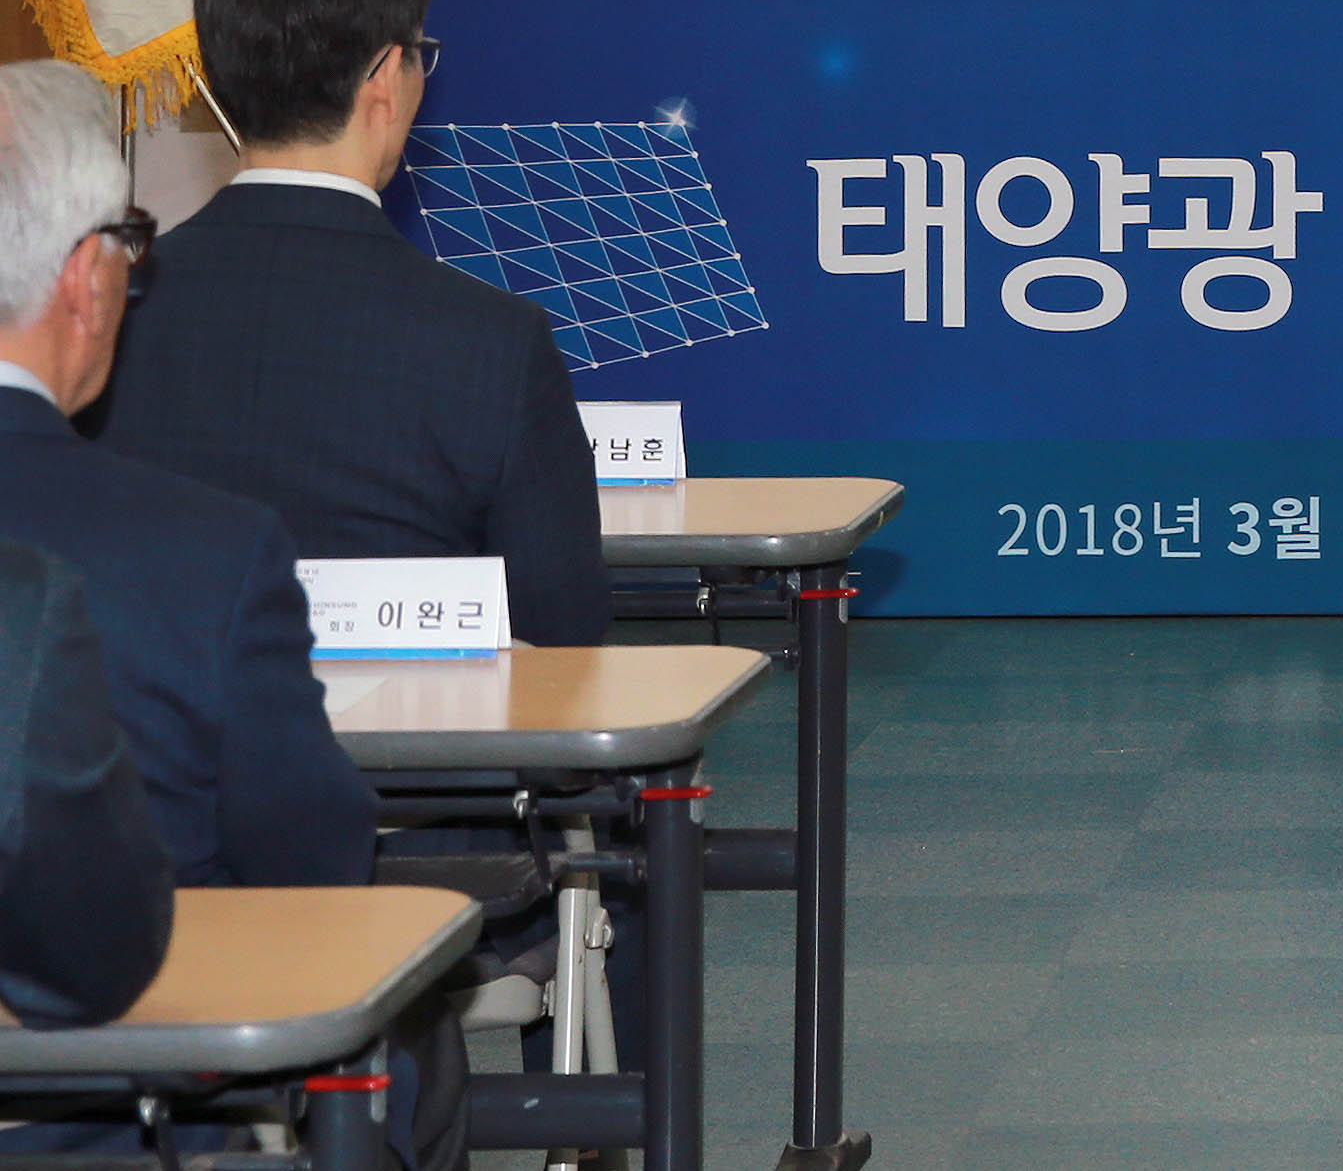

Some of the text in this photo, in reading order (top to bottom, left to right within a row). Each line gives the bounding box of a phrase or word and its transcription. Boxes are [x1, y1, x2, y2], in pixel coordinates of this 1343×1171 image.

[806, 150, 1324, 332] 태양광
[997, 497, 1202, 558] 2018년
[1227, 496, 1321, 560] 3월
[377, 601, 483, 629] 이완근
